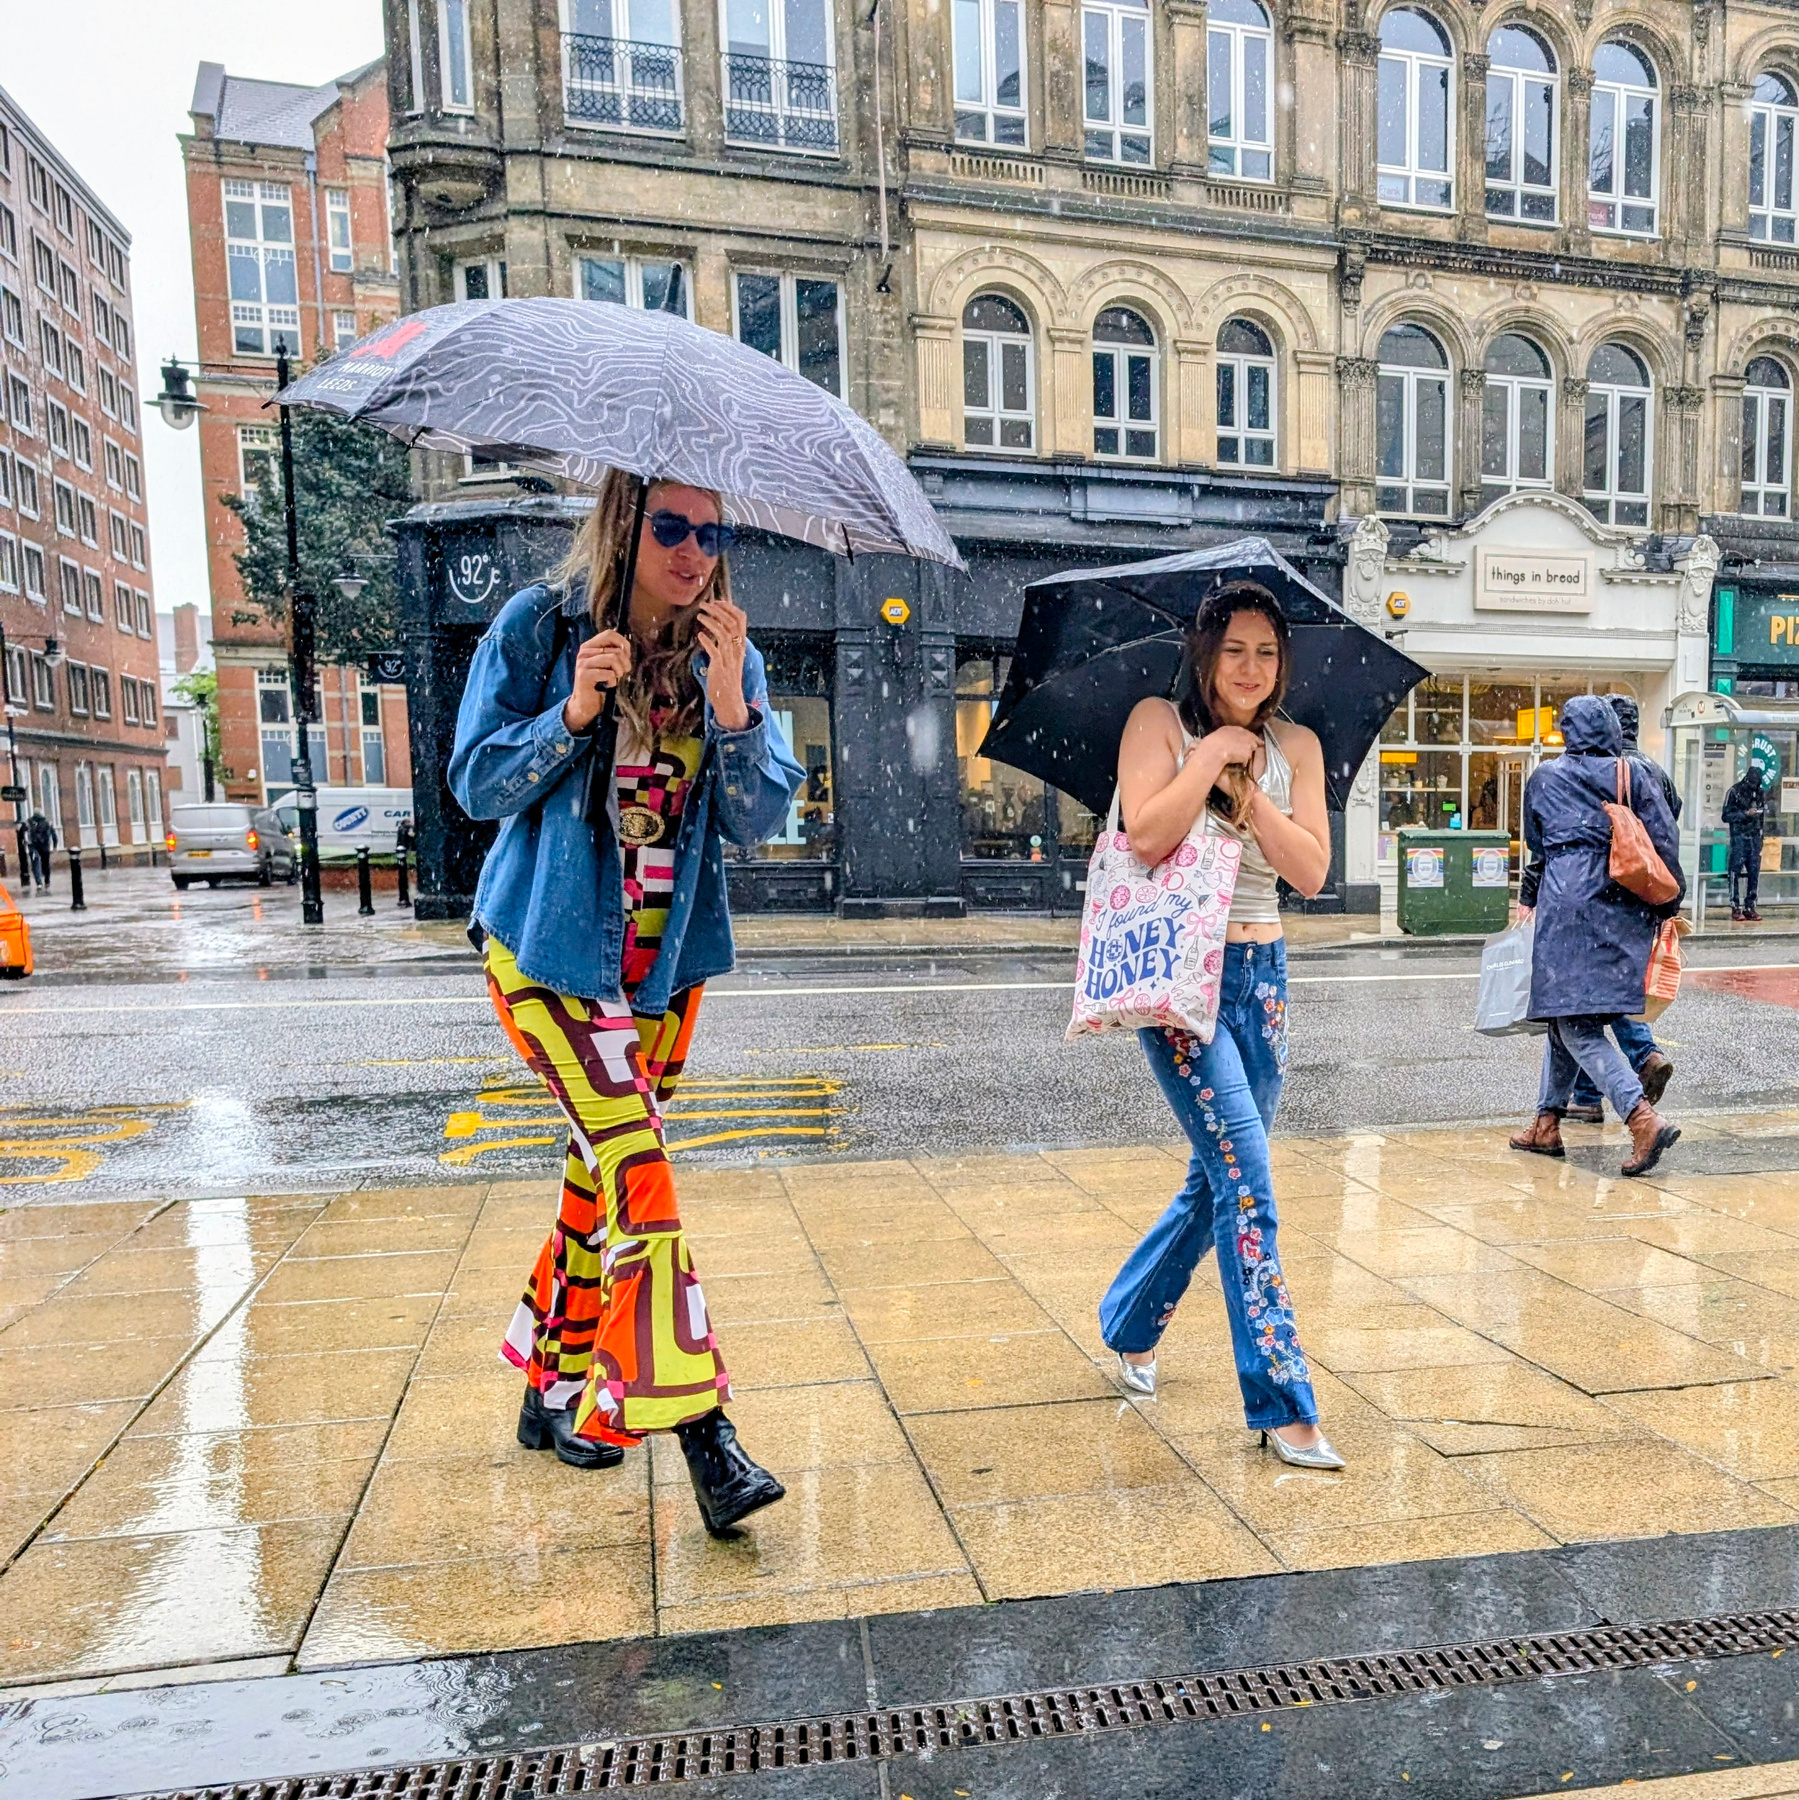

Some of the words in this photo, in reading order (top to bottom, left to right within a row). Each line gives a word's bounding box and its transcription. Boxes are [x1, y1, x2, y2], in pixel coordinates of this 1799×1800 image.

[316, 379, 358, 392] LEEDS
[1491, 566, 1526, 585] things
[1531, 571, 1541, 582] in
[1546, 569, 1580, 584] bread
[1394, 600, 1406, 608] ADT
[1538, 597, 1546, 606] by
[890, 608, 903, 616] ADT
[1737, 744, 1748, 758] IN
[1762, 768, 1777, 785] WE
[384, 810, 411, 818] CAR
[1096, 909, 1107, 931] I
[1106, 890, 1165, 941] found
[1164, 893, 1193, 919] my
[1084, 947, 1182, 1000] HONEY
